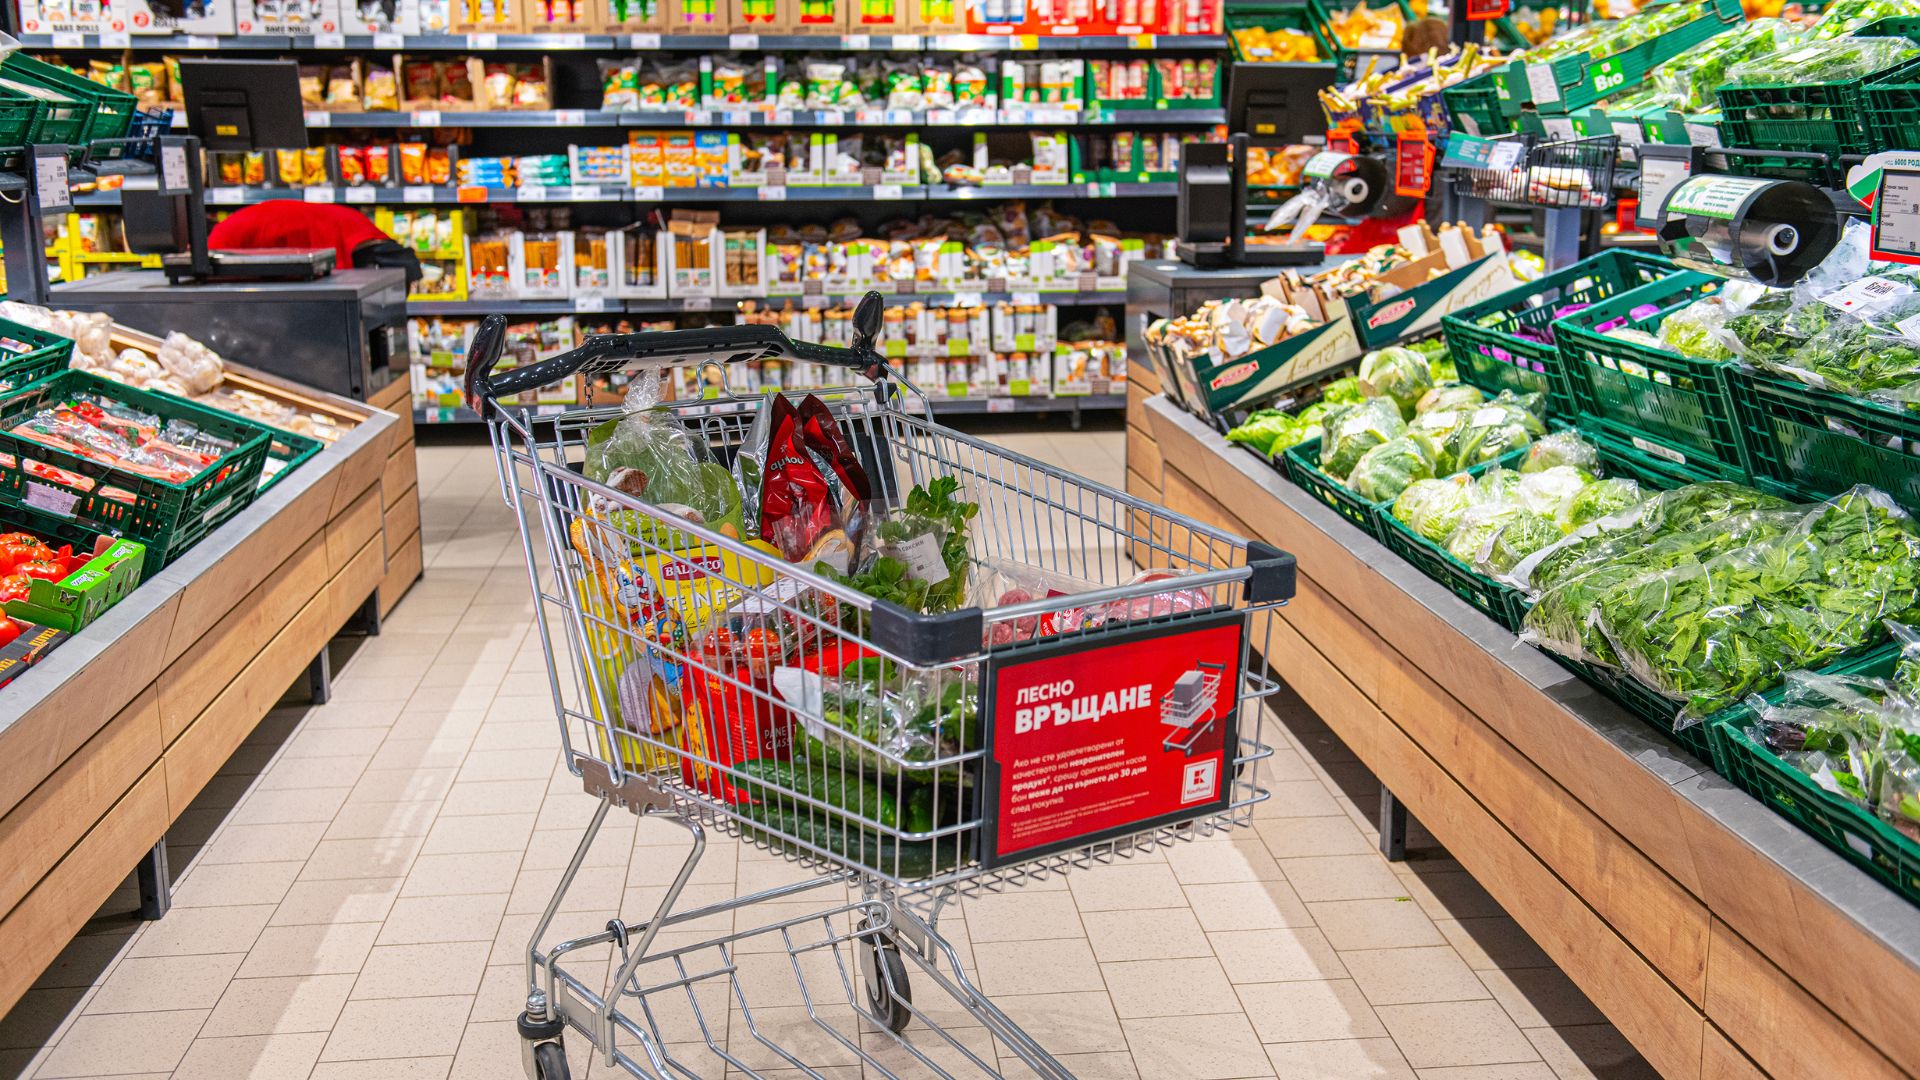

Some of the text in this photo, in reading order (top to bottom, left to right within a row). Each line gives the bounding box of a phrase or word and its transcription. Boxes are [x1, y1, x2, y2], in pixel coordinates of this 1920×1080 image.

[1016, 679, 1074, 706] ЛЕСНО
[1015, 684, 1152, 734] ВРЪЩАНЕ
[1012, 750, 1125, 780] качеството на нехранителен
[1014, 760, 1029, 768] Ако
[1042, 754, 1055, 762] сте
[1056, 742, 1114, 760] удовлетворени
[1116, 738, 1124, 746] от
[1054, 772, 1079, 783] срещу
[1080, 761, 1125, 776] оригинален
[1126, 755, 1147, 766] касов
[1011, 794, 1028, 804] бон
[1028, 789, 1050, 800] може
[1052, 786, 1064, 795] да
[1075, 776, 1107, 789] върнете
[1108, 772, 1119, 782] до
[1120, 768, 1130, 778] 30
[1131, 766, 1148, 776] дни
[1010, 804, 1031, 814] след
